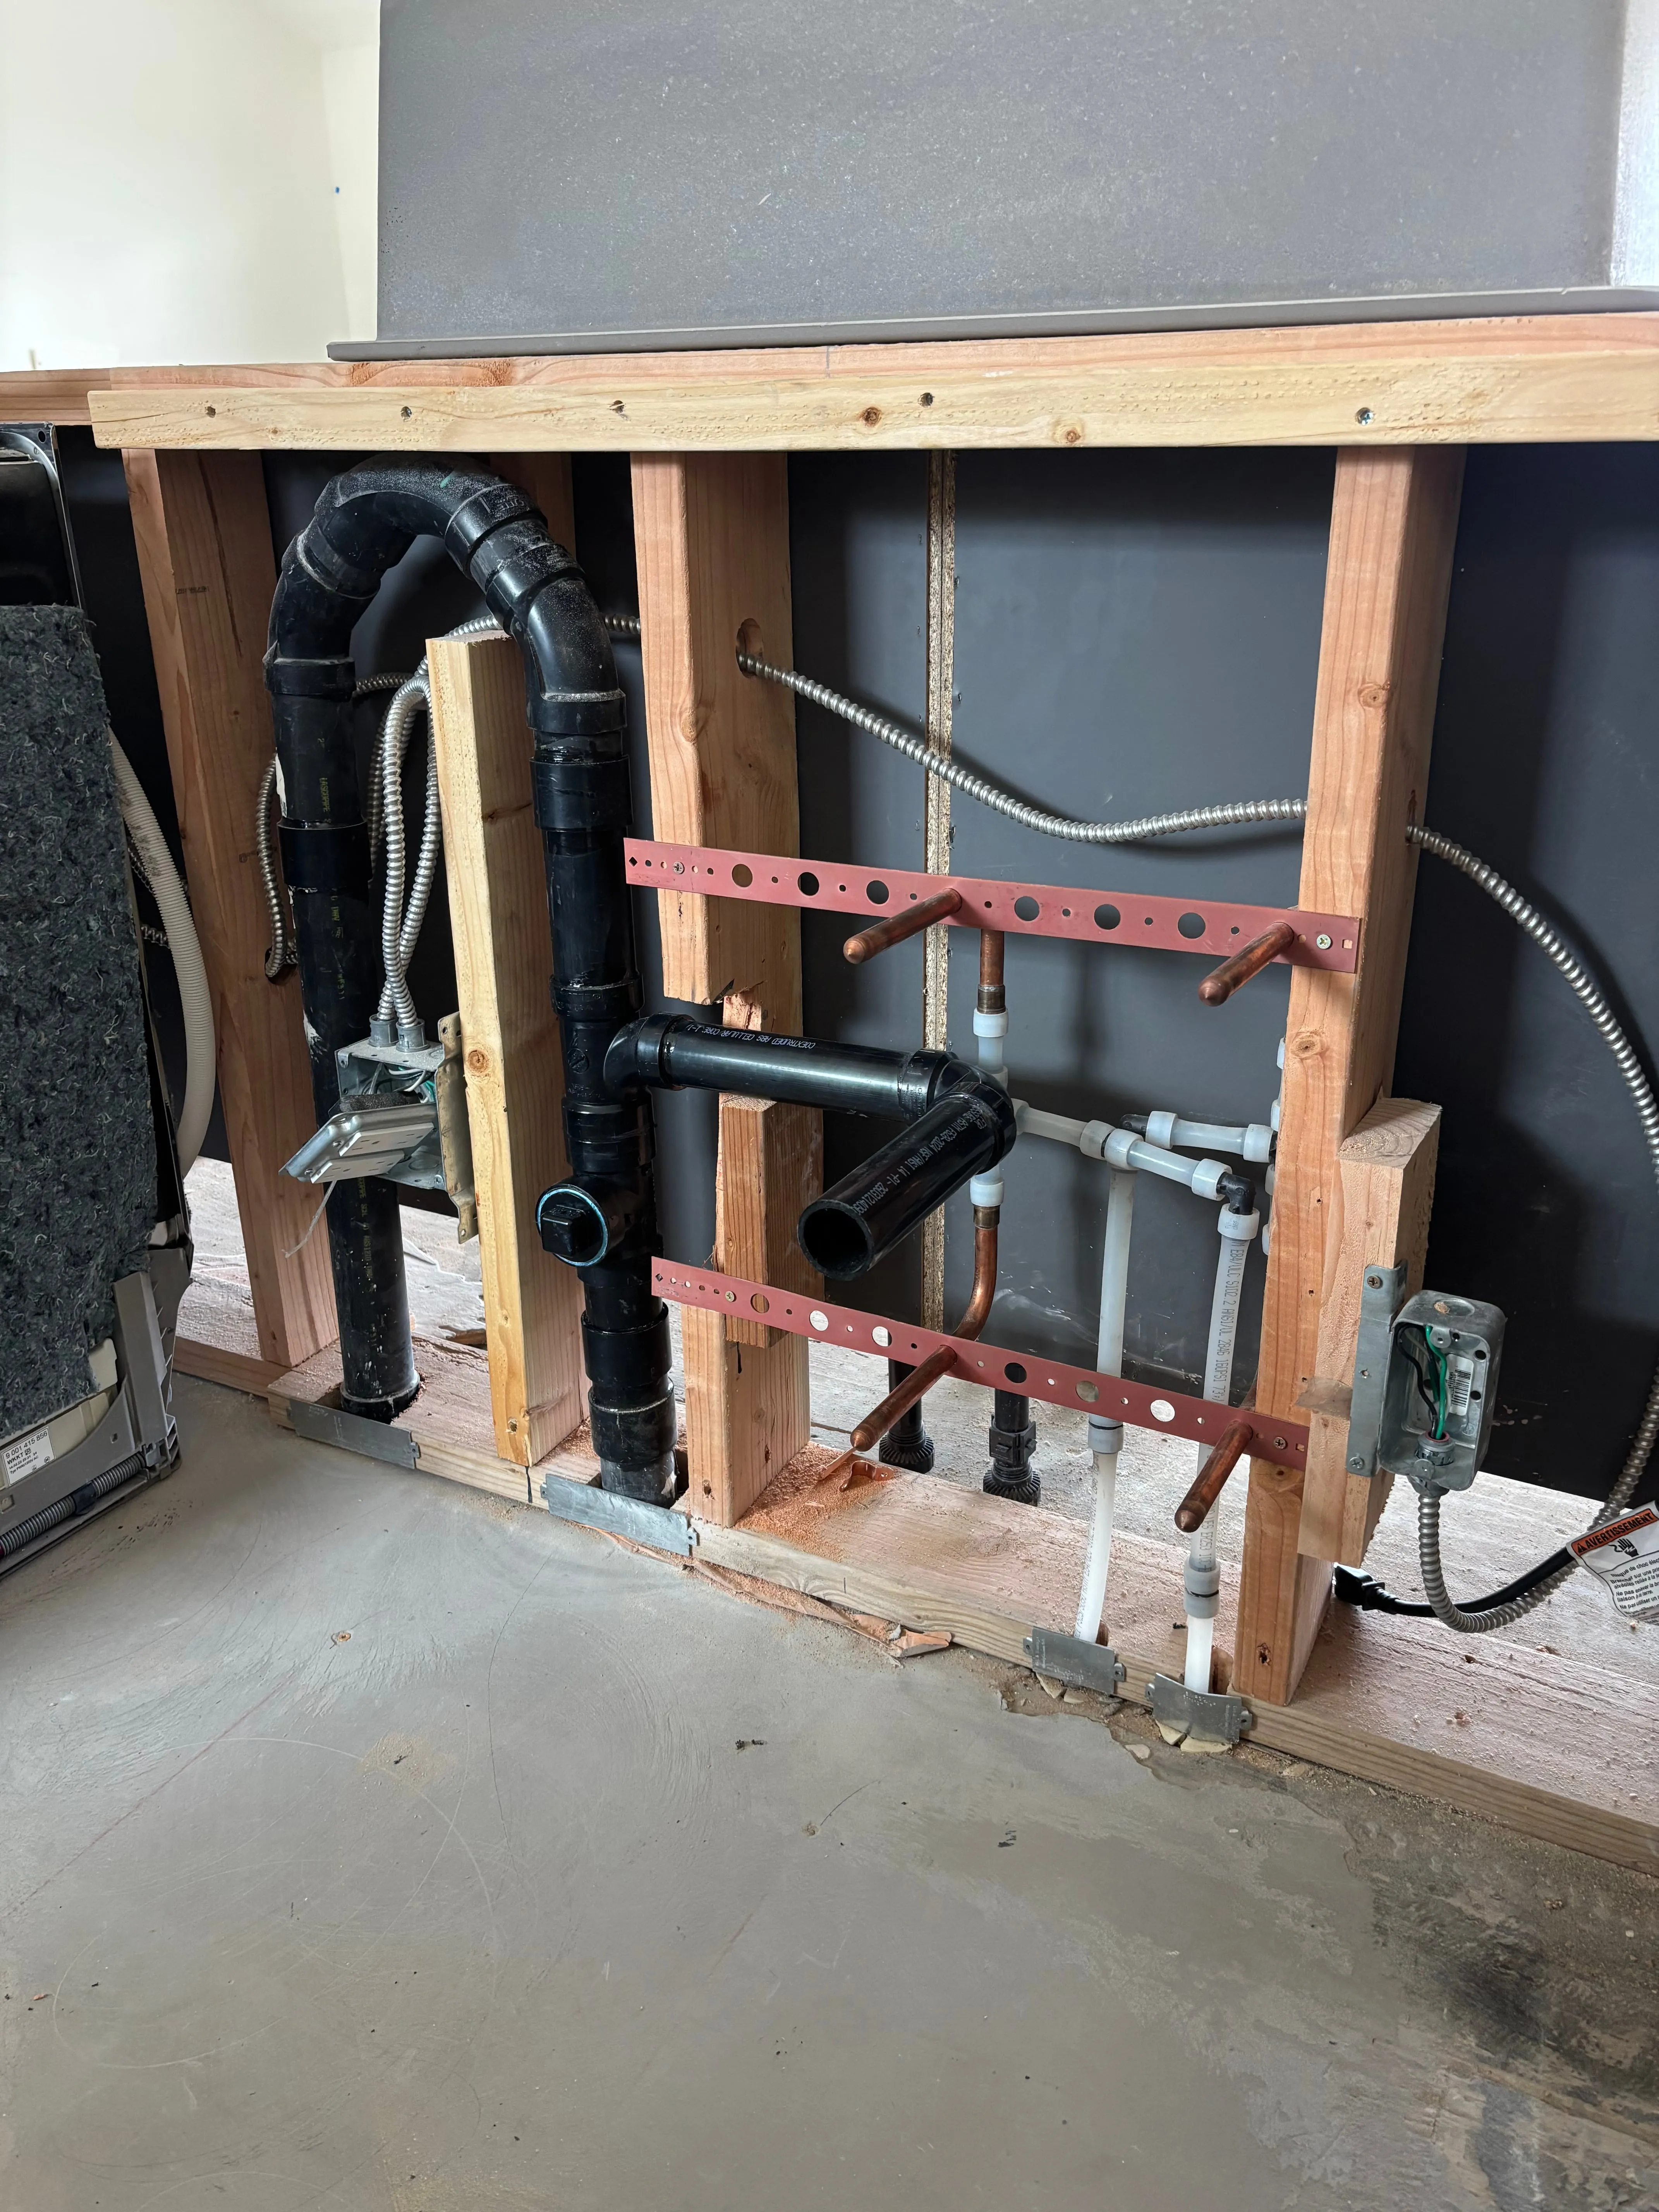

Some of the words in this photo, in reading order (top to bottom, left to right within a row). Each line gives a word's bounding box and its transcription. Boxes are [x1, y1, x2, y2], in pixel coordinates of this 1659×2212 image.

[721, 1030, 755, 1041] CELLULAR
[756, 1035, 771, 1043] ABS
[771, 1038, 816, 1049] COEXTRUDED
[951, 1116, 968, 1133] ASTM
[905, 1145, 934, 1171] NSF/ANSI
[1227, 1249, 1244, 1278] E84/ULC
[1223, 1280, 1238, 1306] S102.2
[1219, 1308, 1235, 1337] ANSI/UL
[1216, 1338, 1231, 1356] 2846
[1213, 1359, 1228, 1382] 160PSI
[11, 1446, 22, 1456] 001
[24, 1438, 35, 1448] 415
[36, 1431, 47, 1441] 856
[7, 1453, 23, 1465] WKKT
[1585, 1512, 1654, 1549] AVERTISSEMENT
